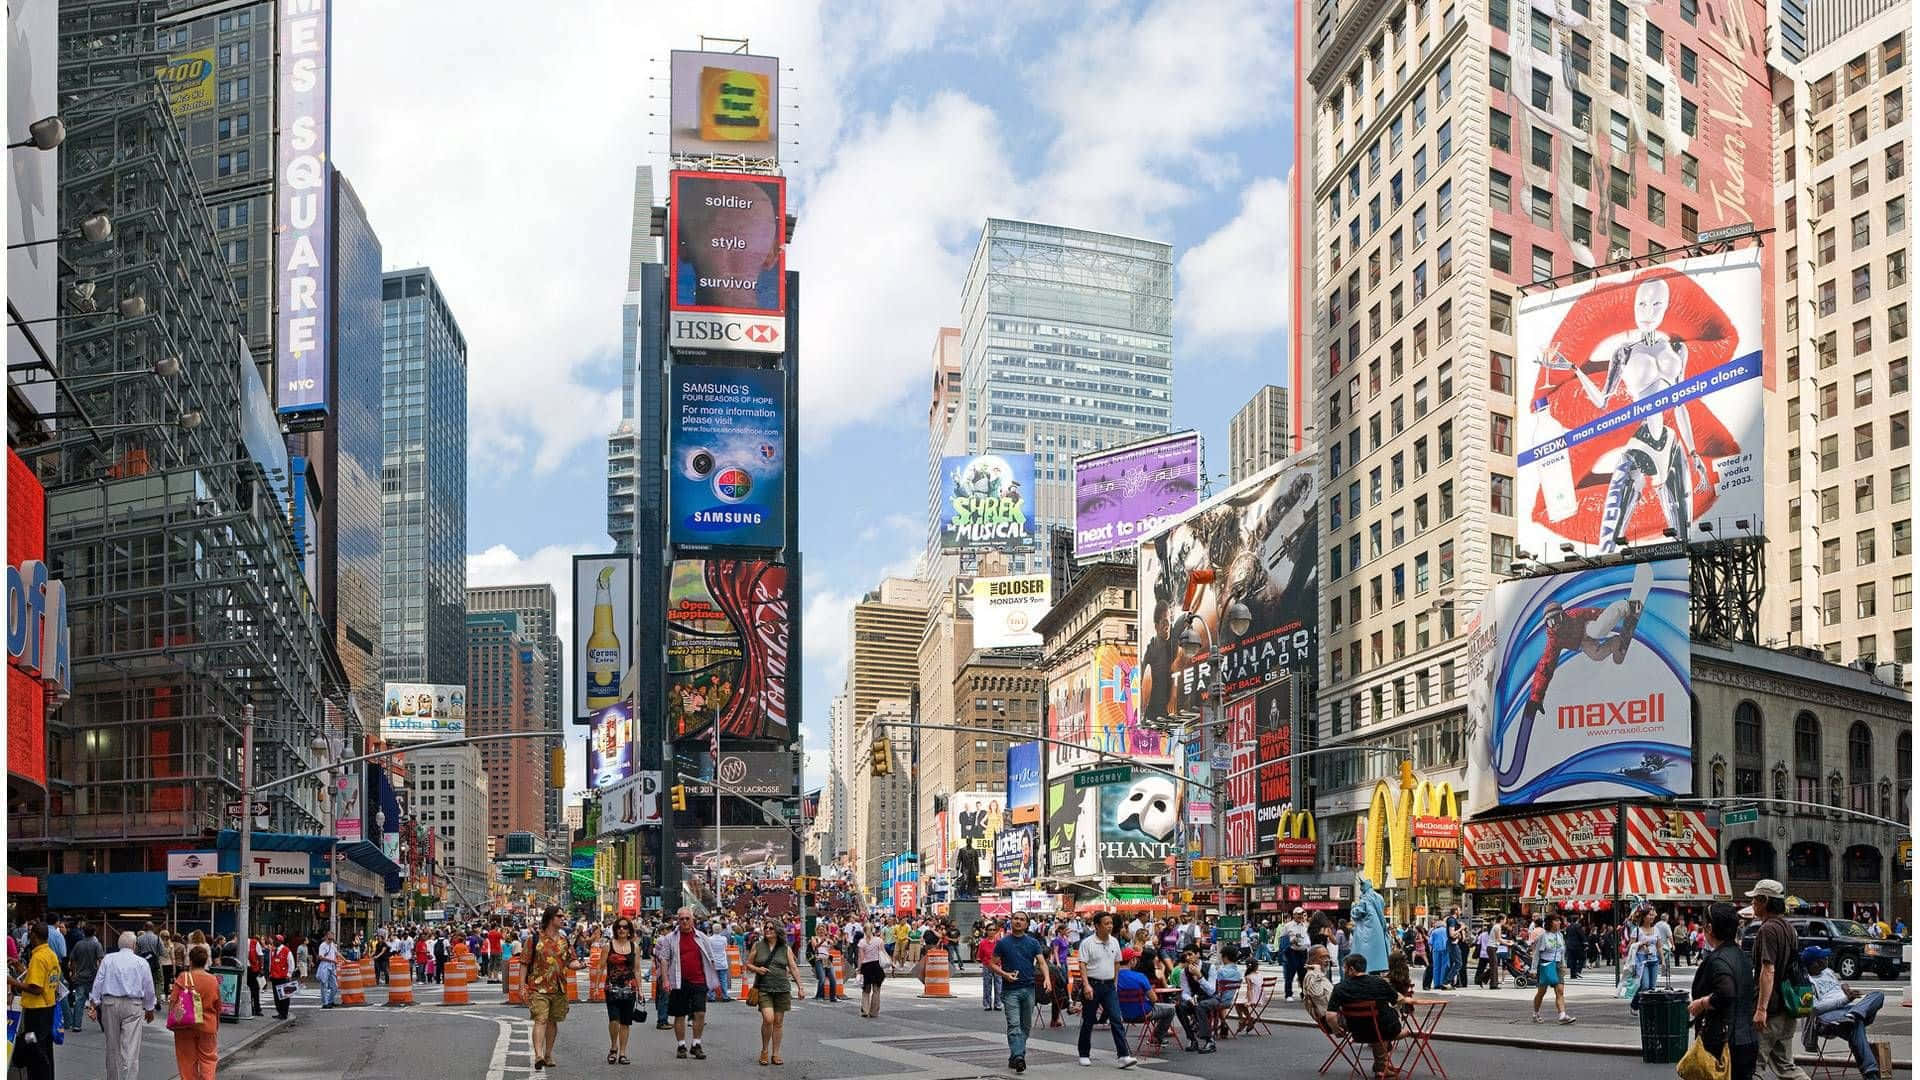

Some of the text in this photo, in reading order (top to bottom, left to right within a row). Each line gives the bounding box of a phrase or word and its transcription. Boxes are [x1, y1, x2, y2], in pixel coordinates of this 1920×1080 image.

[1710, 133, 1752, 222] Juan
[705, 195, 753, 209] soldier
[286, 115, 323, 354] SQUARE
[712, 236, 746, 250] style
[699, 276, 758, 290] survivor
[676, 320, 742, 341] HSBC
[289, 378, 314, 391] NYC
[682, 382, 750, 395] SAMSUNG'S
[705, 395, 739, 403] SEASONS
[752, 397, 774, 405] HOPE
[1572, 366, 1748, 442] man cannot live on gossip alone.
[682, 405, 776, 417] For more information
[682, 415, 733, 425] please visit
[1533, 437, 1567, 458] SVEDKA
[1717, 453, 1752, 468] voted #1
[1724, 465, 1749, 477] vodka
[1721, 481, 1730, 490] of
[952, 496, 1026, 525] SHREK
[694, 511, 761, 524] SAMSUNG
[955, 521, 1028, 541] MUSICAL
[1079, 522, 1113, 544] next
[1116, 519, 1134, 537] to
[998, 579, 1044, 596] CLOSER
[989, 597, 1028, 606] MONDAYS
[589, 648, 617, 659] Corona
[1558, 693, 1664, 729] maxell
[1587, 725, 1664, 737] www.maxell.com
[1081, 772, 1122, 785] Broadway
[743, 784, 780, 793] LACROSSE
[1261, 776, 1290, 802] THING
[1416, 822, 1458, 830] McDonald's
[1477, 841, 1501, 850] FRIDAY'S
[1522, 836, 1548, 847] FRIDAY'S
[267, 866, 304, 875] TISHMAN
